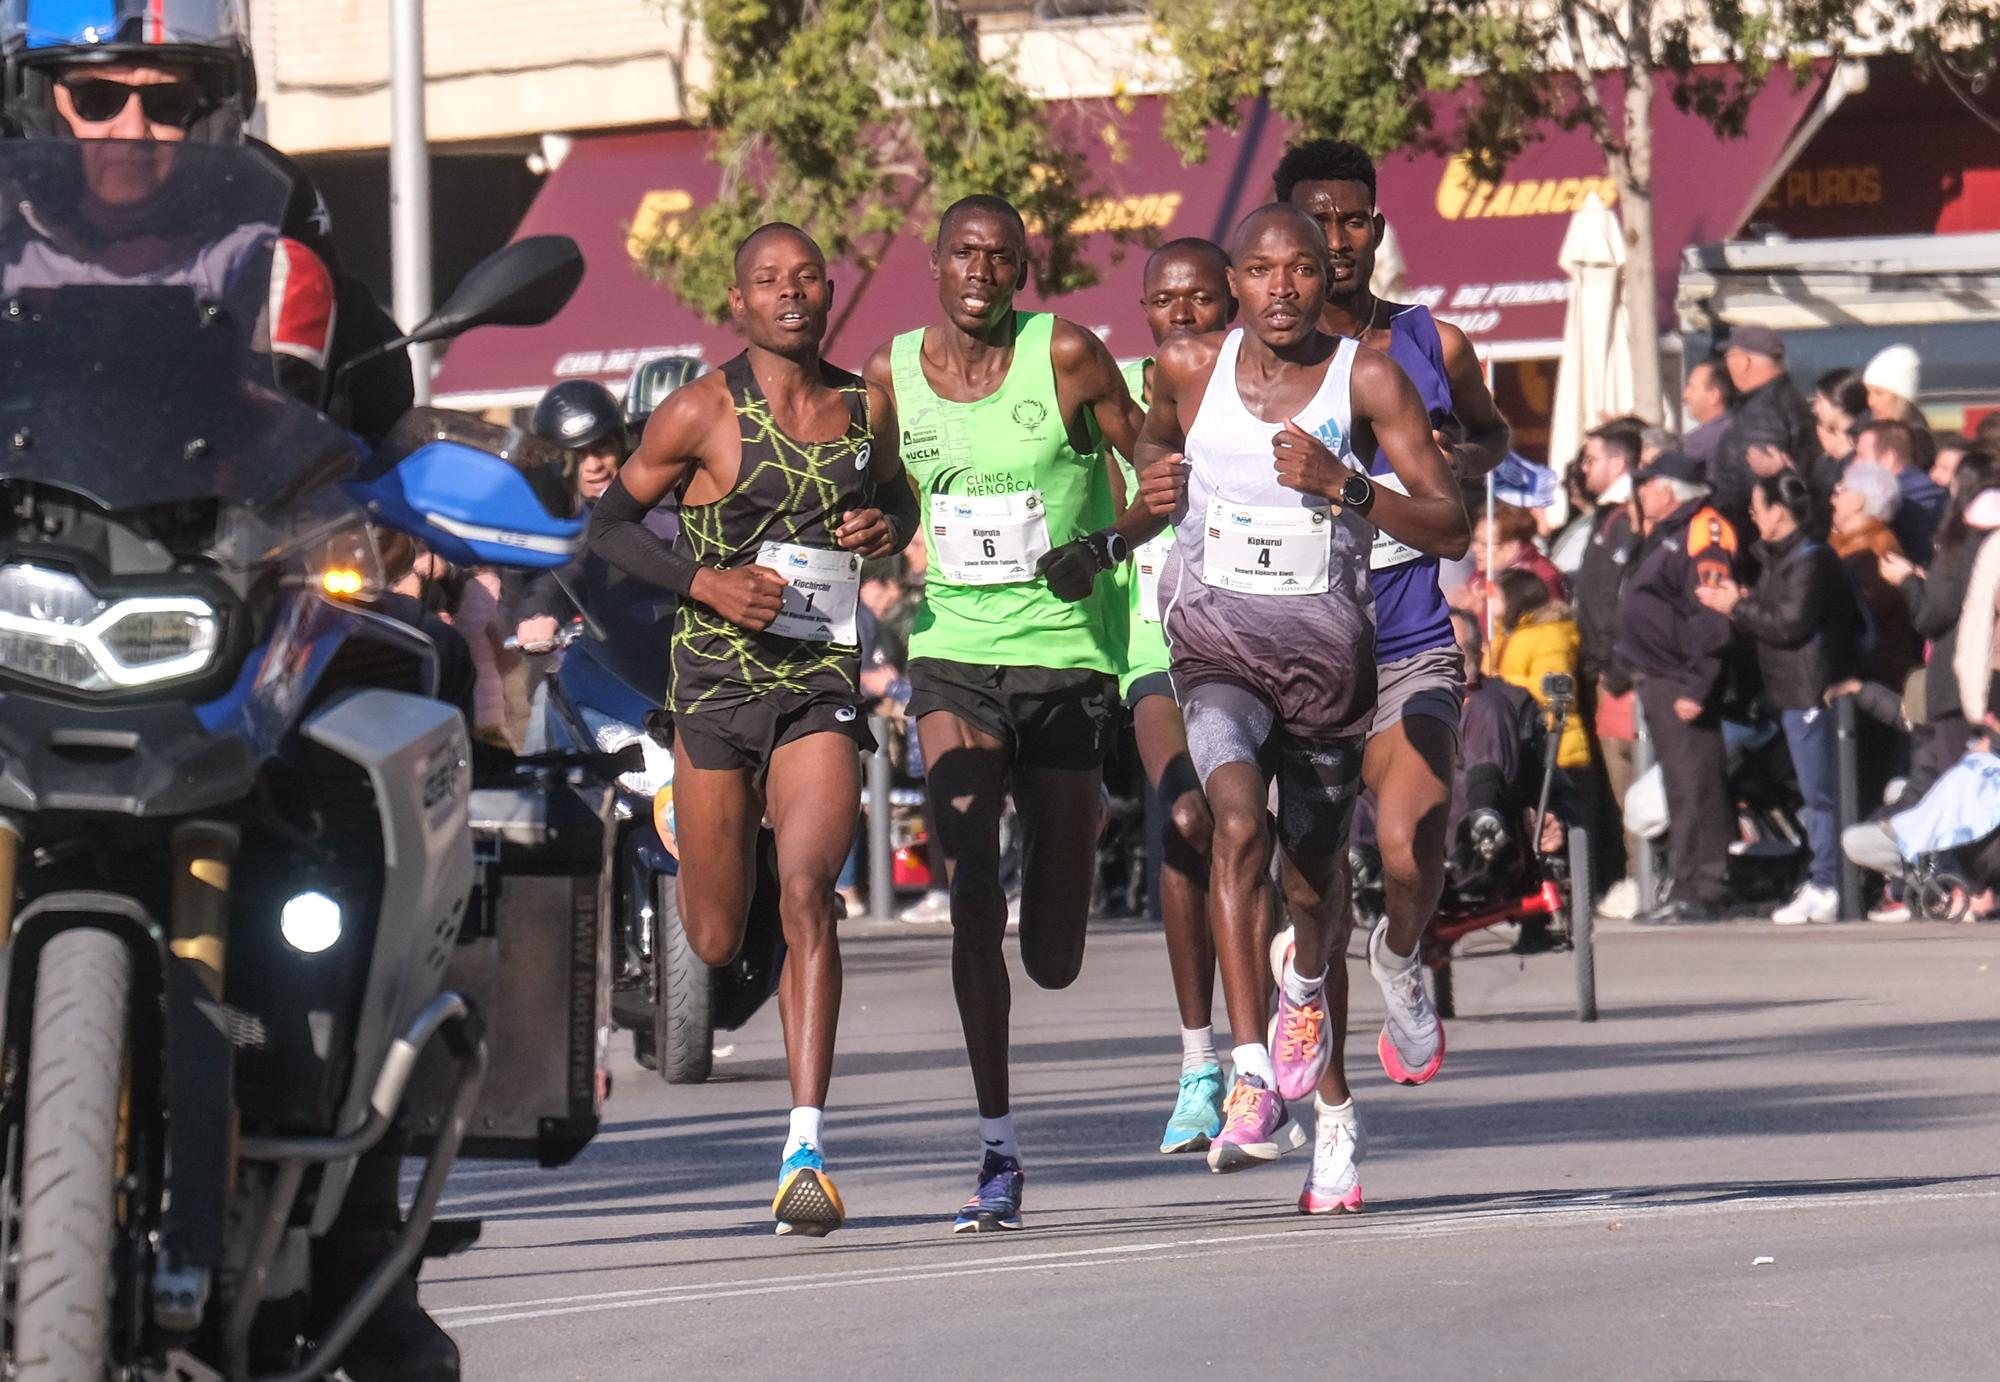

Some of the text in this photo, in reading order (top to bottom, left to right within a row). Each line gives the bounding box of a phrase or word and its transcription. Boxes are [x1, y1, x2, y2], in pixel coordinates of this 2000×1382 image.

[1464, 176, 1618, 219] TABACOS
[1787, 167, 1881, 208] PUROS
[911, 448, 940, 460] UCLM
[966, 472, 1013, 486] CLÍNICA
[967, 480, 1035, 497] MENORCA
[982, 538, 996, 558] 6
[1247, 537, 1283, 547] Kipkurui
[1257, 548, 1272, 568] 4
[805, 592, 816, 613] 1
[575, 895, 594, 966] BMW
